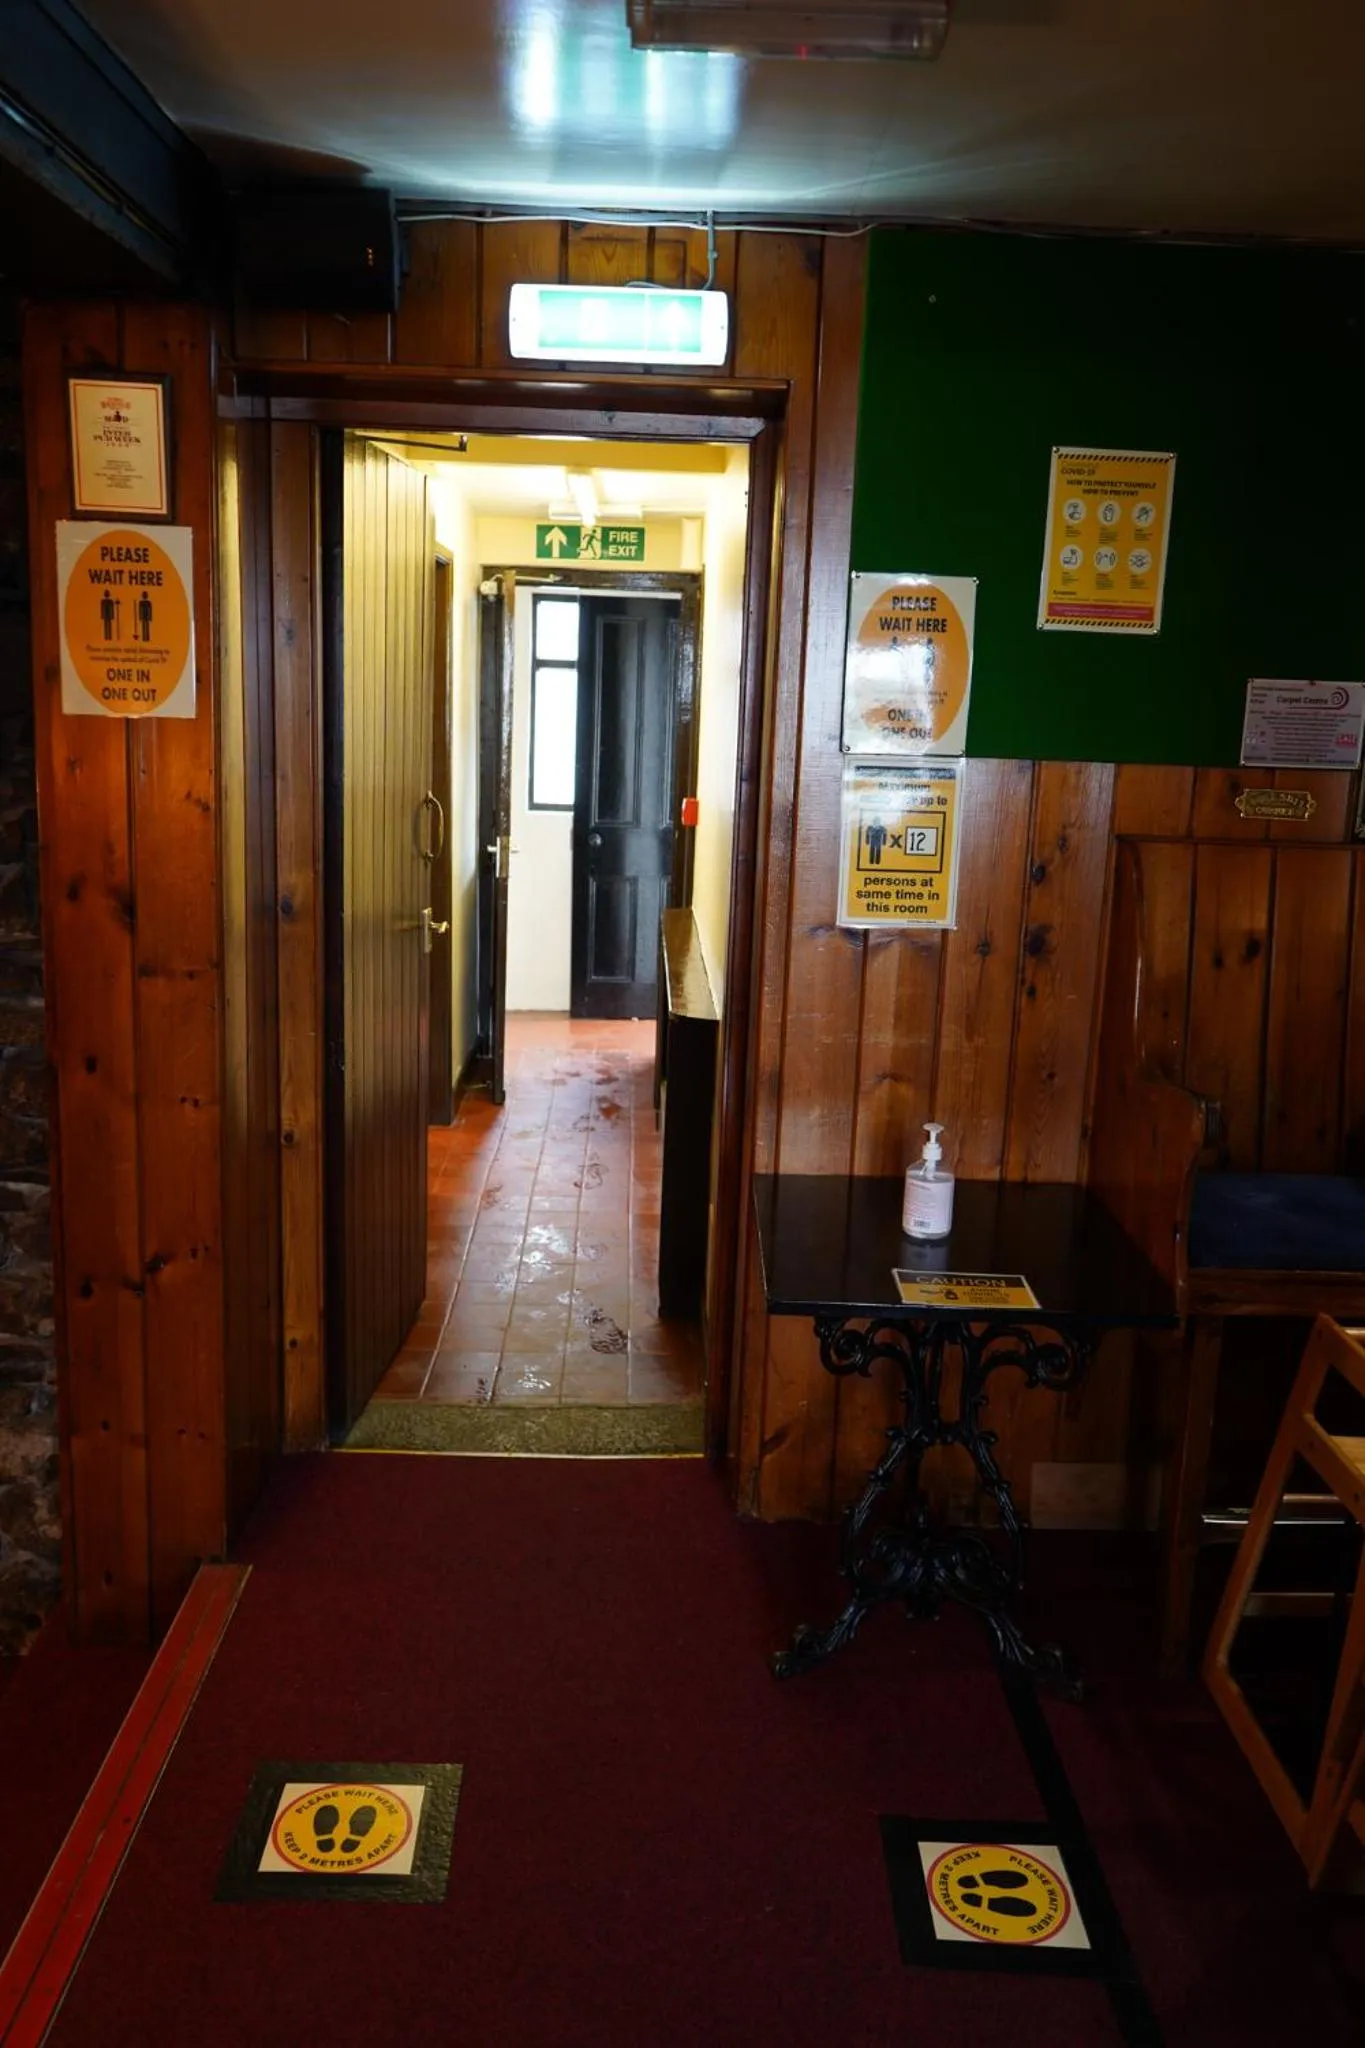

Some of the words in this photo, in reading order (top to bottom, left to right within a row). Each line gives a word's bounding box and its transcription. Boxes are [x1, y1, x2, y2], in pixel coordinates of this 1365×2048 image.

[609, 531, 639, 543] FIRE
[101, 546, 149, 563] PLEASE
[608, 545, 638, 557] EXIT
[88, 569, 124, 584] WAIT
[128, 571, 163, 586] HERE
[891, 596, 937, 612] PLEASE
[879, 617, 913, 631] WAIT
[916, 618, 947, 633] HERE
[106, 668, 132, 682] ONE
[136, 669, 150, 682] IN
[102, 687, 128, 700] ONE
[132, 688, 157, 702] OUT
[937, 795, 948, 806] to
[909, 831, 927, 852] 12
[864, 876, 918, 888] persons
[921, 876, 934, 887] at
[856, 889, 892, 900] same
[895, 889, 924, 900] time
[927, 890, 940, 900] in
[866, 902, 890, 912] this
[893, 903, 928, 914] room
[915, 1275, 1007, 1288] CAUTION
[295, 1790, 340, 1815] PLEASE
[344, 1789, 374, 1799] WAIT
[376, 1795, 399, 1816] HERE
[284, 1831, 301, 1854] KEEP
[299, 1852, 308, 1860] 2
[309, 1856, 364, 1868] METRES
[367, 1833, 395, 1860] APART
[952, 1850, 982, 1865] KEEP
[1009, 1855, 1052, 1886] PLEASE
[939, 1872, 959, 1912] METRES
[1046, 1887, 1059, 1911] WAIT
[957, 1913, 1000, 1936] APART
[1027, 1912, 1055, 1935] HERE
